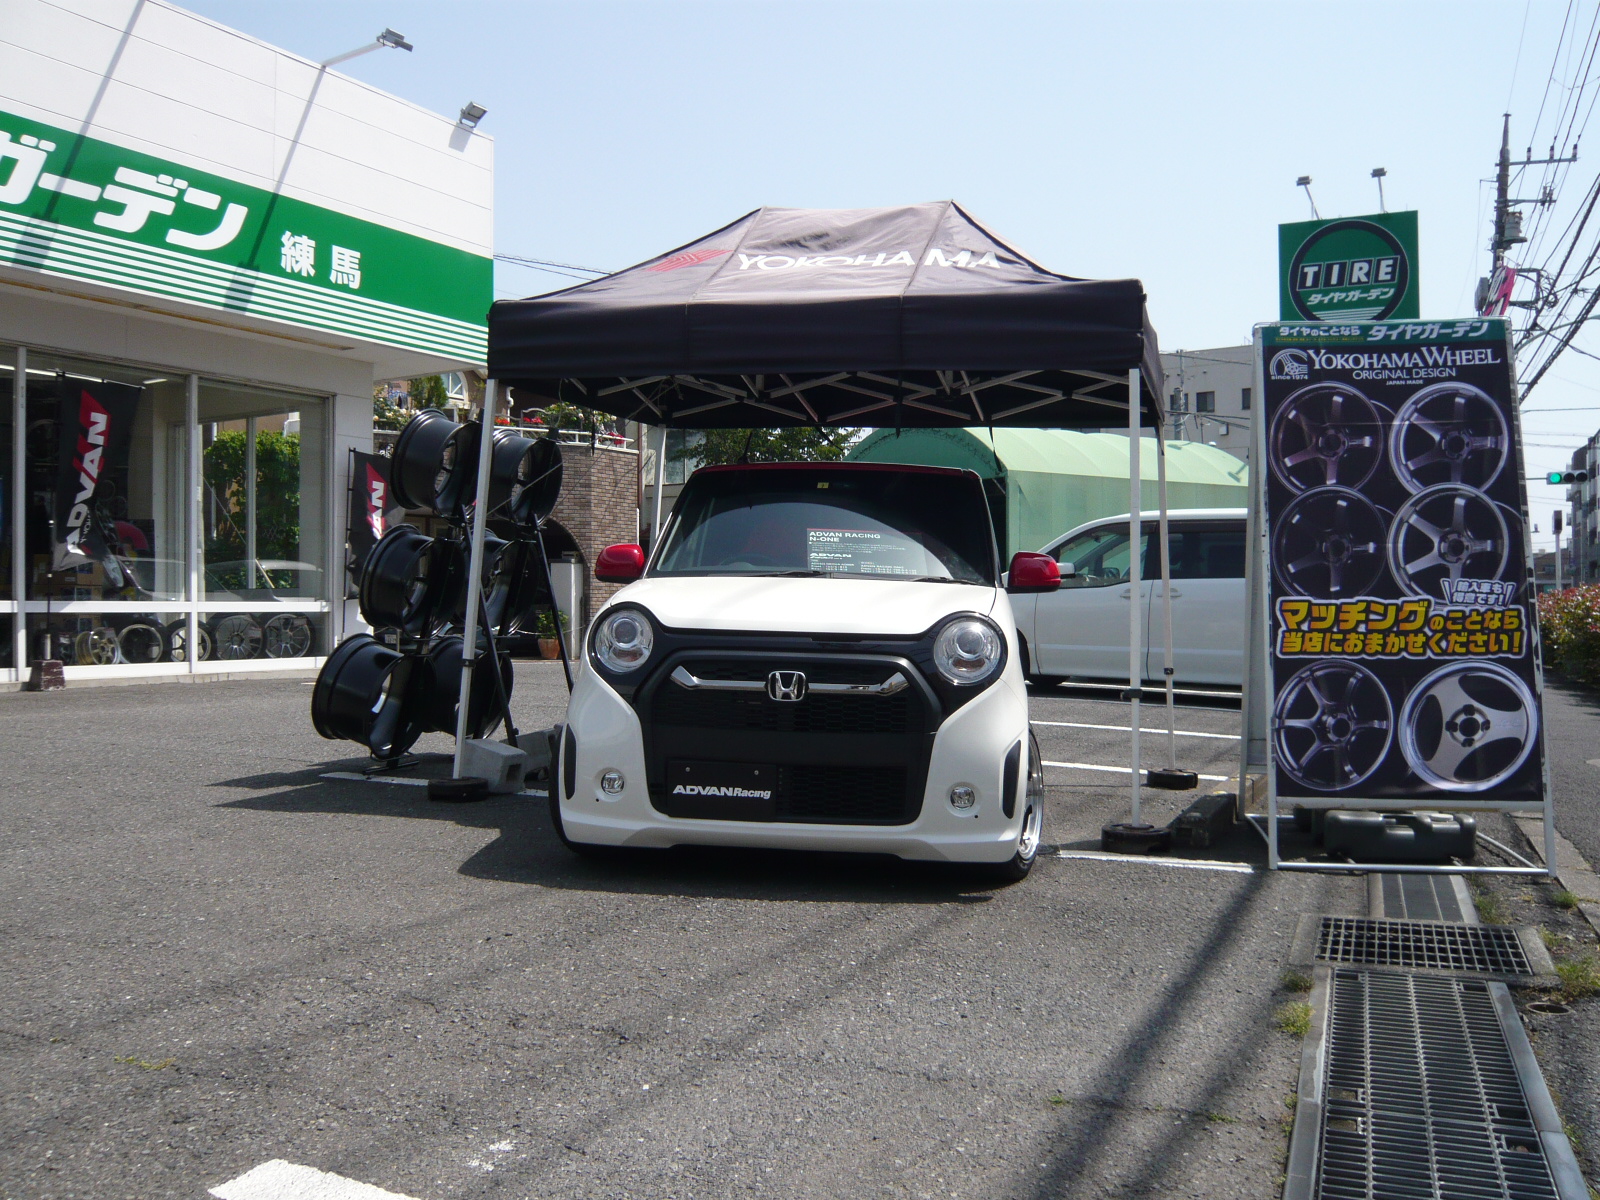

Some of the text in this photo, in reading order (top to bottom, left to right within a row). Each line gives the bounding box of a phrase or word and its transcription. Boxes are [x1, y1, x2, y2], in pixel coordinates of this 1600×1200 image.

[280, 230, 362, 290] 練馬
[736, 248, 1001, 270] YOKOHAMA
[1303, 259, 1394, 287] TIRE
[1307, 288, 1395, 305] タイヤガーデン
[1279, 321, 1490, 341] タイヤのことなら タイヤガーデン
[1307, 346, 1501, 370] YOKOHAMA WHEEL
[1353, 367, 1456, 380] ORIGINAL DESIGN
[1281, 600, 1520, 631] マッチングのことなら
